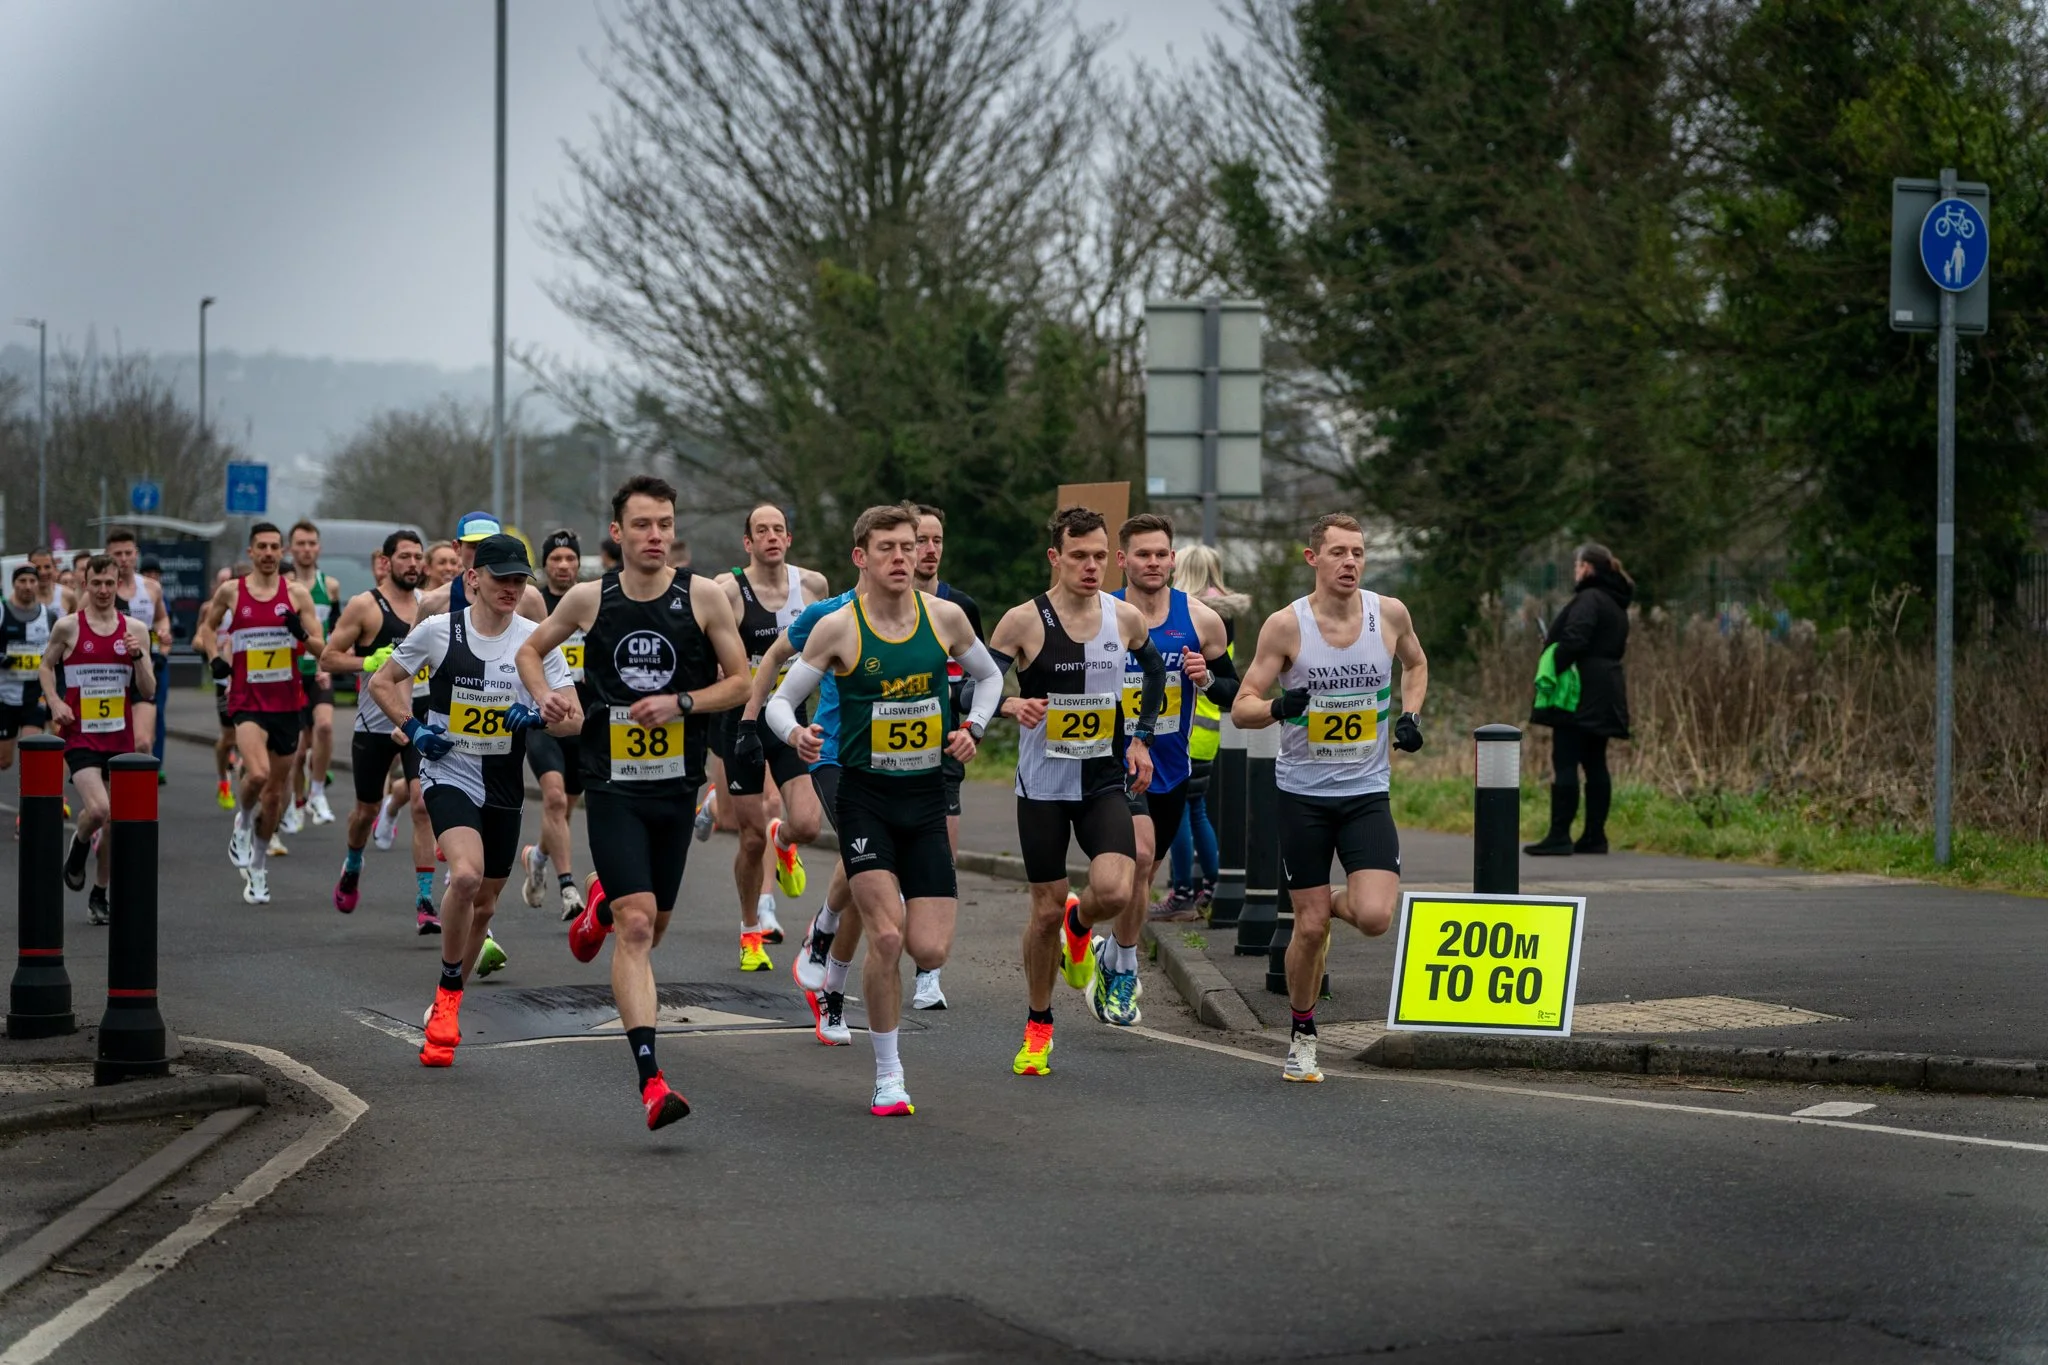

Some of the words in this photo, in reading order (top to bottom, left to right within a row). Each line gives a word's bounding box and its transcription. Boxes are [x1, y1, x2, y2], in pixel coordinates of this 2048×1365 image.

[1042, 608, 1056, 628] soar
[628, 637, 661, 655] CDF
[263, 650, 276, 669] 7
[566, 648, 578, 667] 5
[1055, 661, 1113, 672] PONTYPRIDD
[1308, 664, 1378, 679] SWANSEA
[455, 676, 512, 690] PONTYPRIDD
[1308, 675, 1381, 691] HARRIERS
[457, 691, 503, 703] LLISWERRY
[1053, 698, 1103, 706] LLISWERRY
[1315, 699, 1365, 708] LLISWERRY
[1366, 698, 1372, 706] 8
[99, 699, 110, 718] 5
[878, 705, 929, 715] LLISWERRY
[931, 702, 936, 711] 8
[463, 707, 498, 735] 28
[1062, 712, 1100, 738] 29
[1324, 713, 1362, 741] 26
[626, 727, 669, 757] 38
[888, 720, 928, 750] 53
[1437, 920, 1540, 960] 200M
[1425, 963, 1474, 1002] TO
[1488, 965, 1543, 1005] GO
